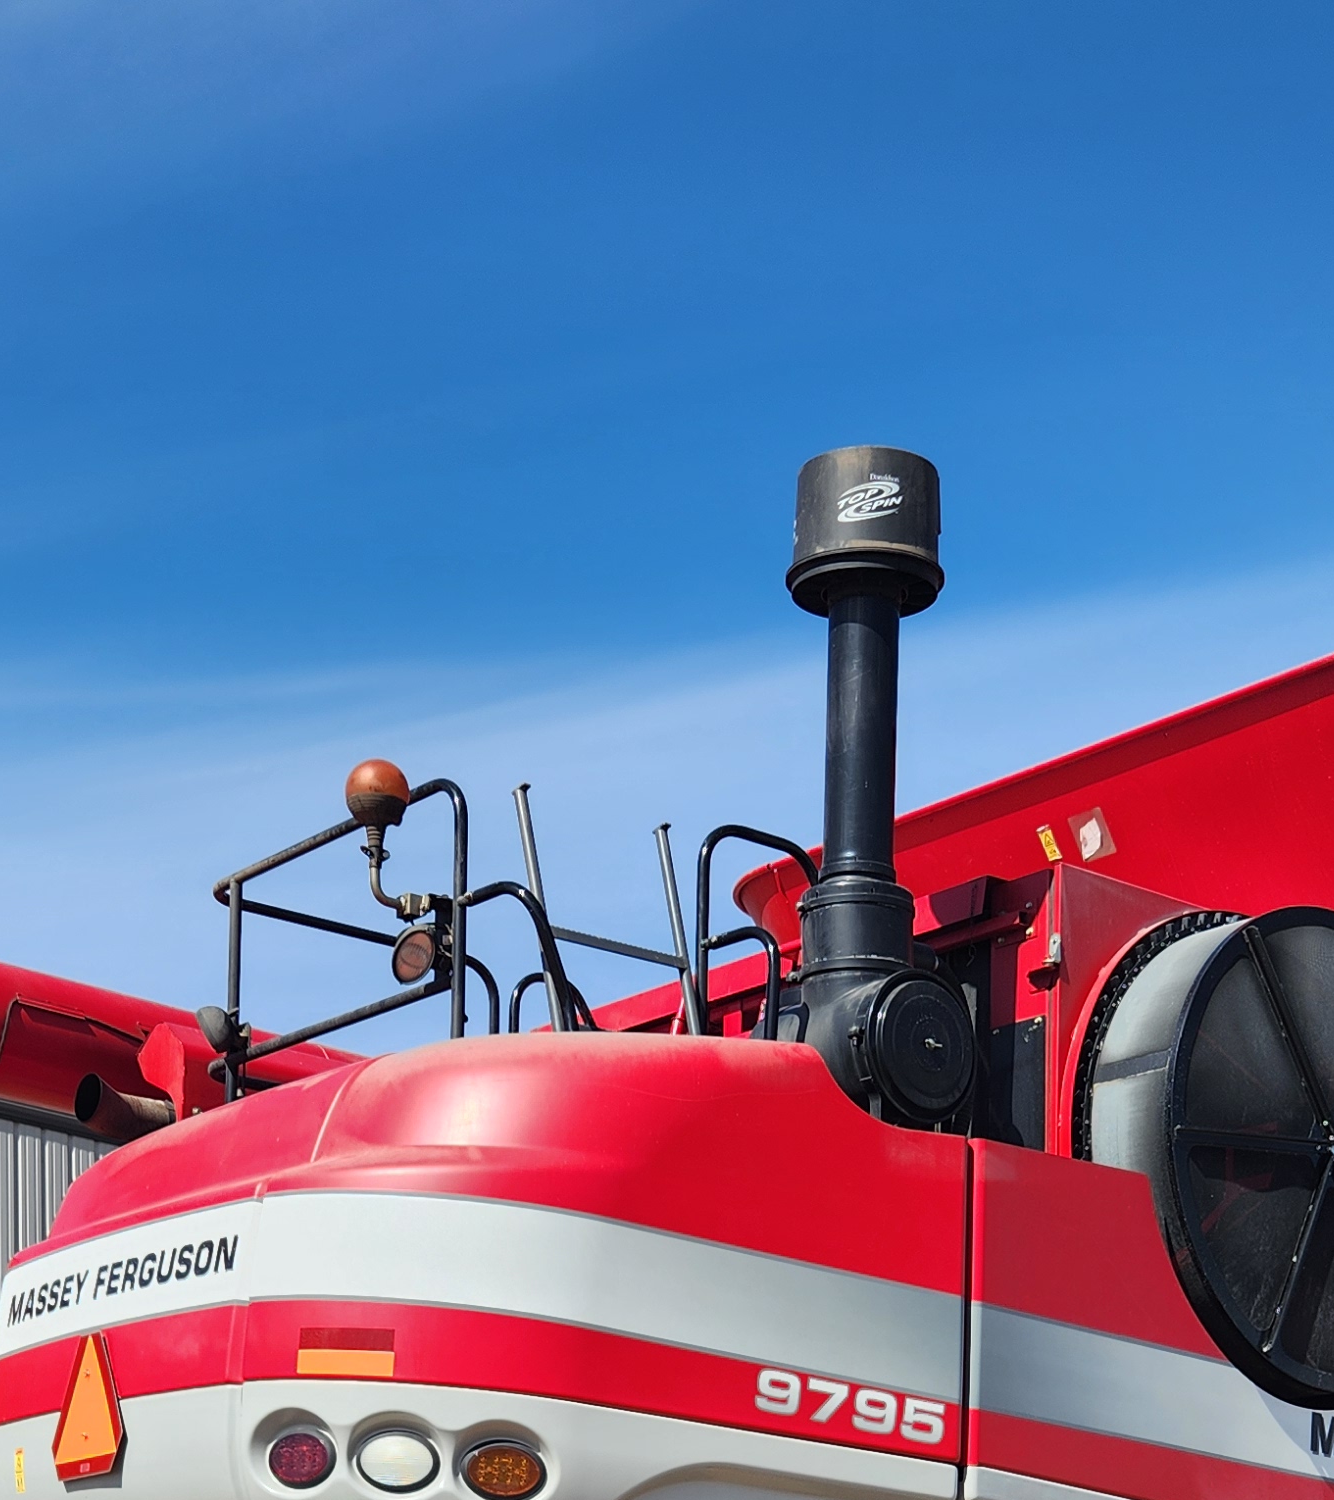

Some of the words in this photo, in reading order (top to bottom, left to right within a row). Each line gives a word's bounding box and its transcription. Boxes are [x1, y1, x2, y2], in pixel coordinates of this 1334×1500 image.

[837, 488, 879, 510] TOP
[859, 495, 904, 513] SPIN
[7, 1269, 89, 1328] MASSEY
[93, 1234, 239, 1301] FERGUSON
[754, 1367, 946, 1445] 9795
